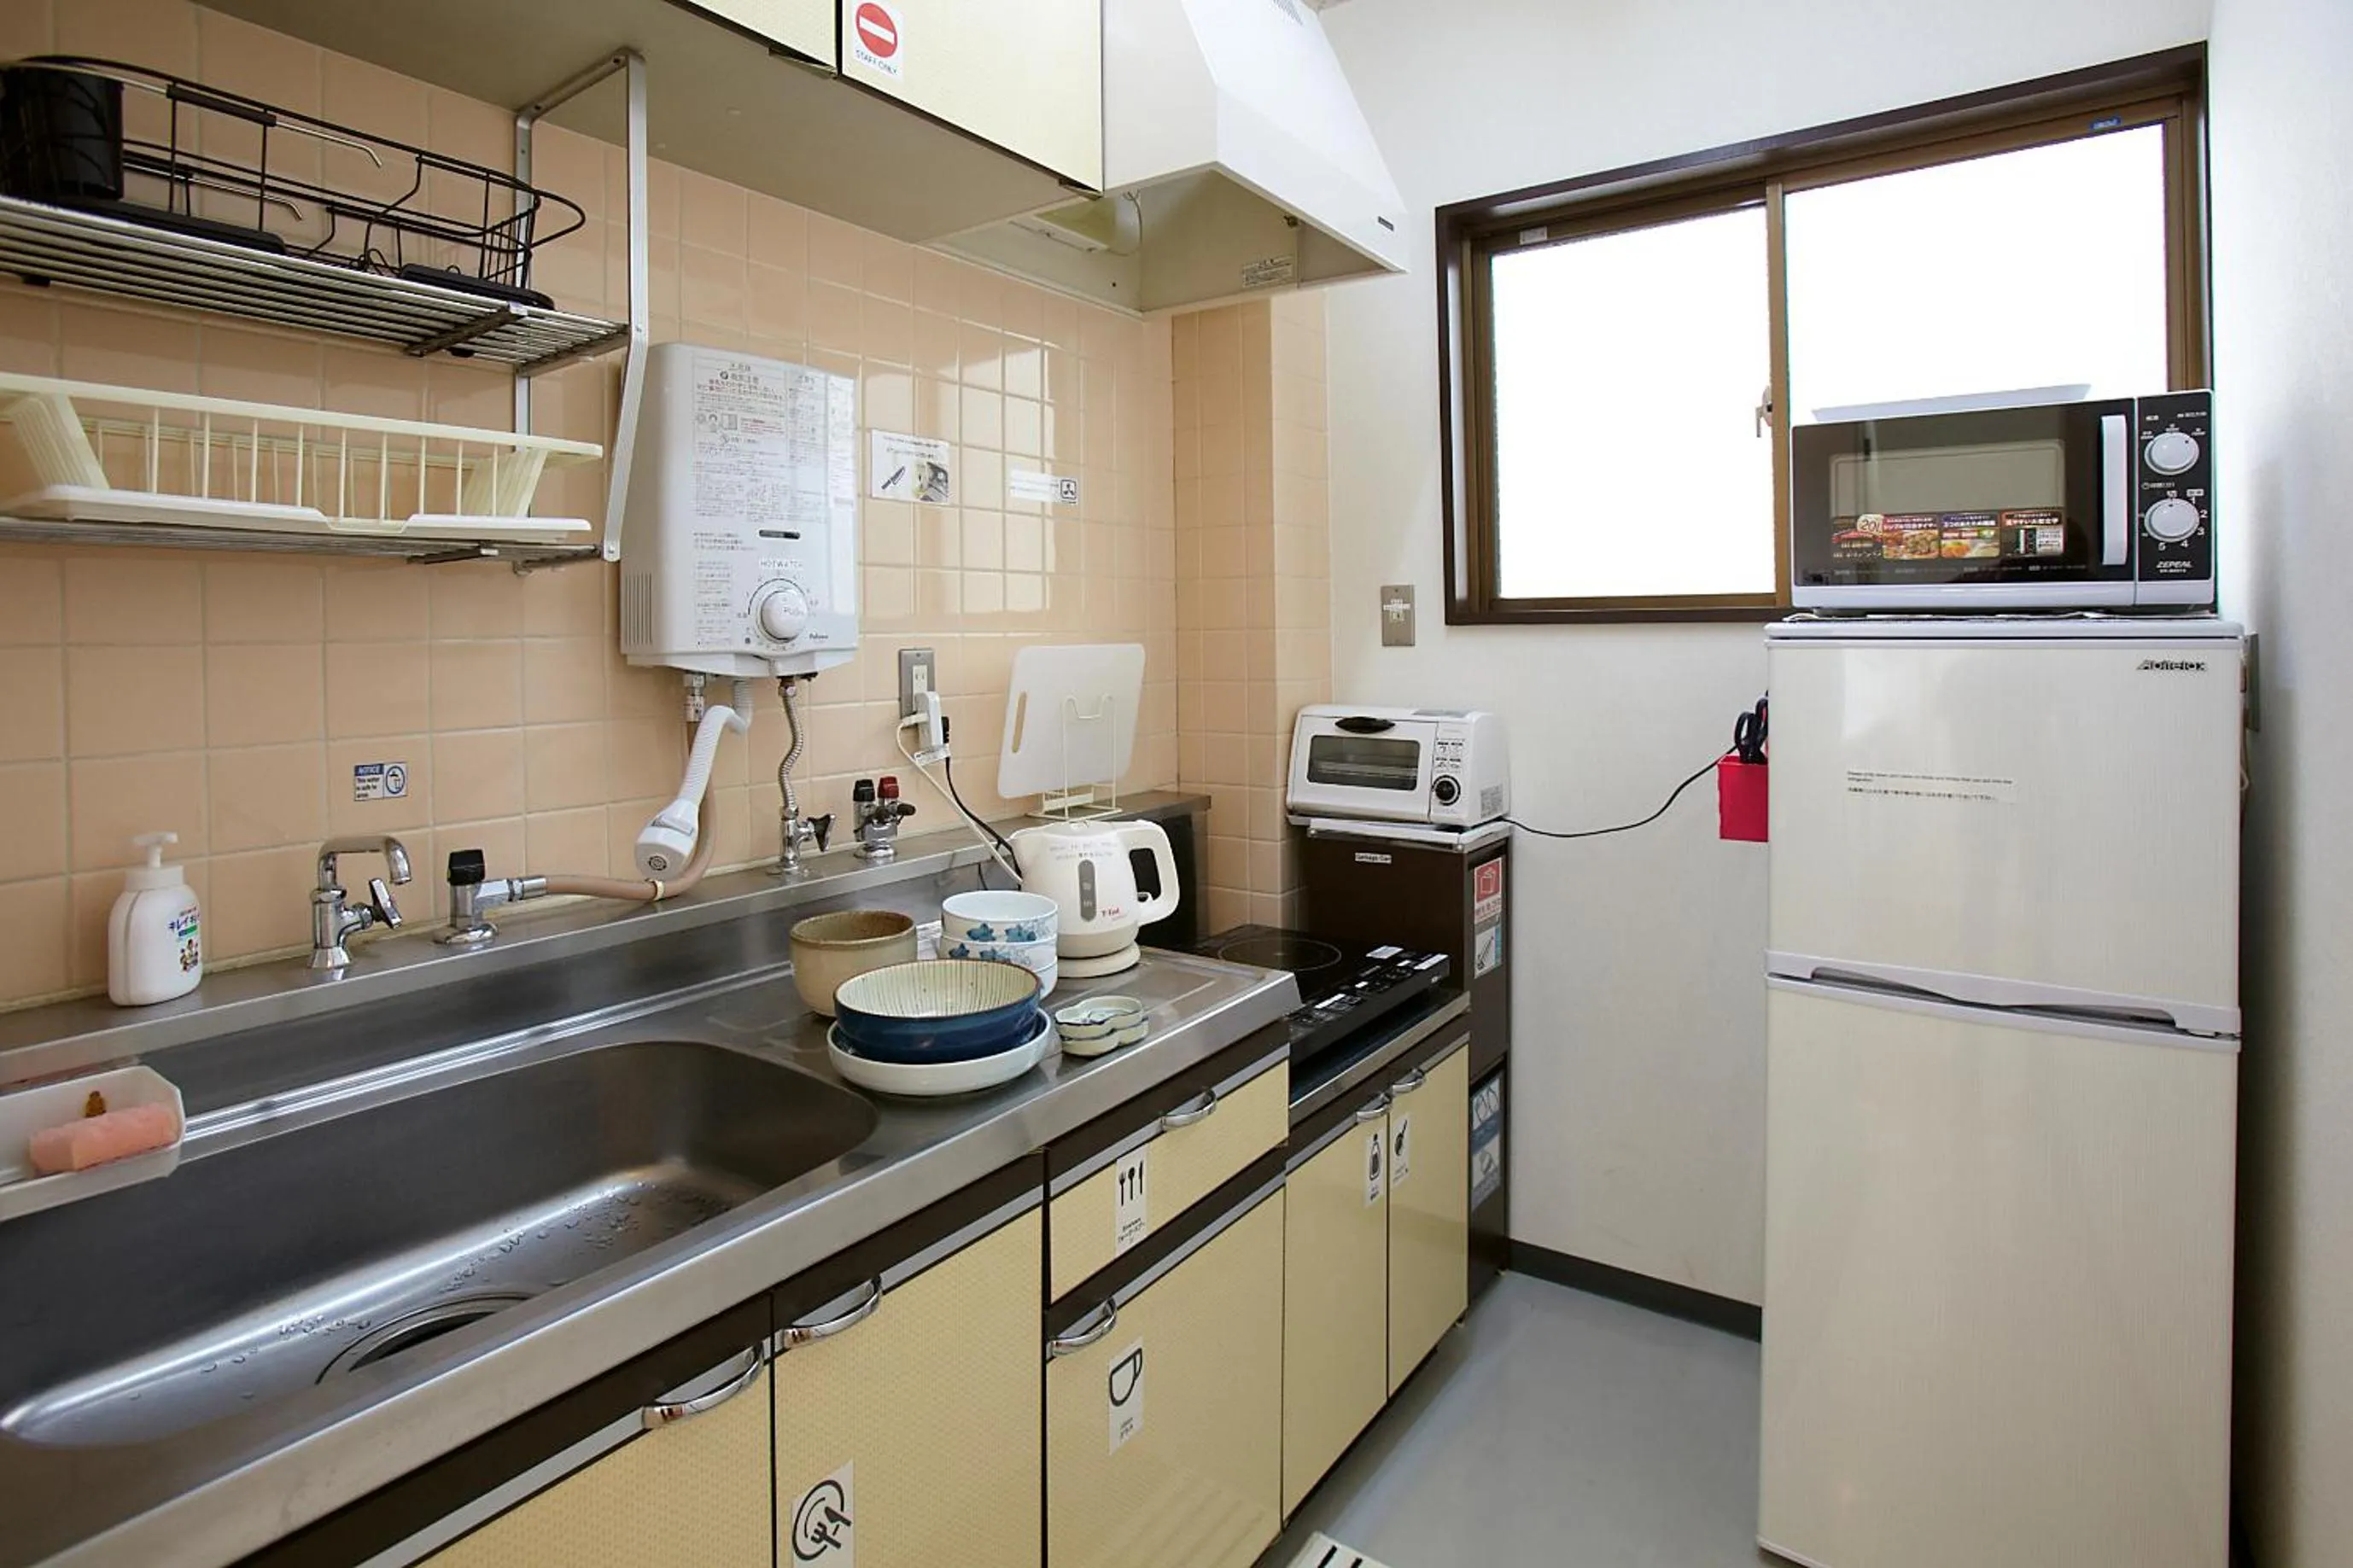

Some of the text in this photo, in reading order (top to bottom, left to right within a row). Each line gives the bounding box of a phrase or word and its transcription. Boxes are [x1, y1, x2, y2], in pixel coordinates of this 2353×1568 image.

[2200, 510, 2208, 518] 2
[2197, 527, 2204, 535] 3
[2180, 539, 2189, 548] 4
